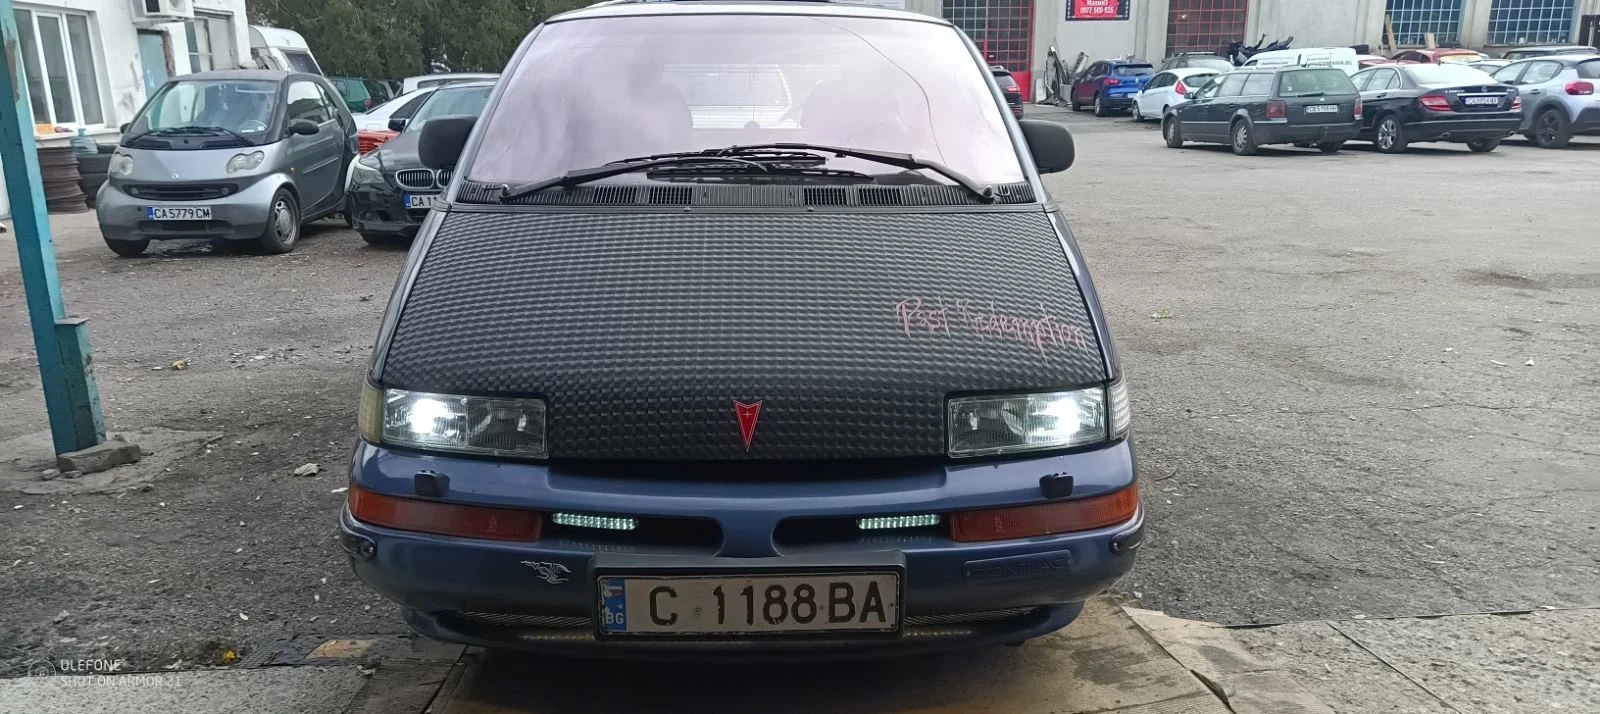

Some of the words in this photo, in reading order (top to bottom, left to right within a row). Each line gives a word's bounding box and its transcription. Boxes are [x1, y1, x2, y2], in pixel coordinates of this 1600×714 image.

[411, 196, 425, 207] CA
[154, 208, 168, 219] CA
[168, 208, 194, 219] 5779
[195, 208, 211, 219] CM
[649, 586, 678, 626] C
[712, 583, 818, 627] 1188
[827, 580, 887, 625] BA
[605, 612, 625, 625] BG
